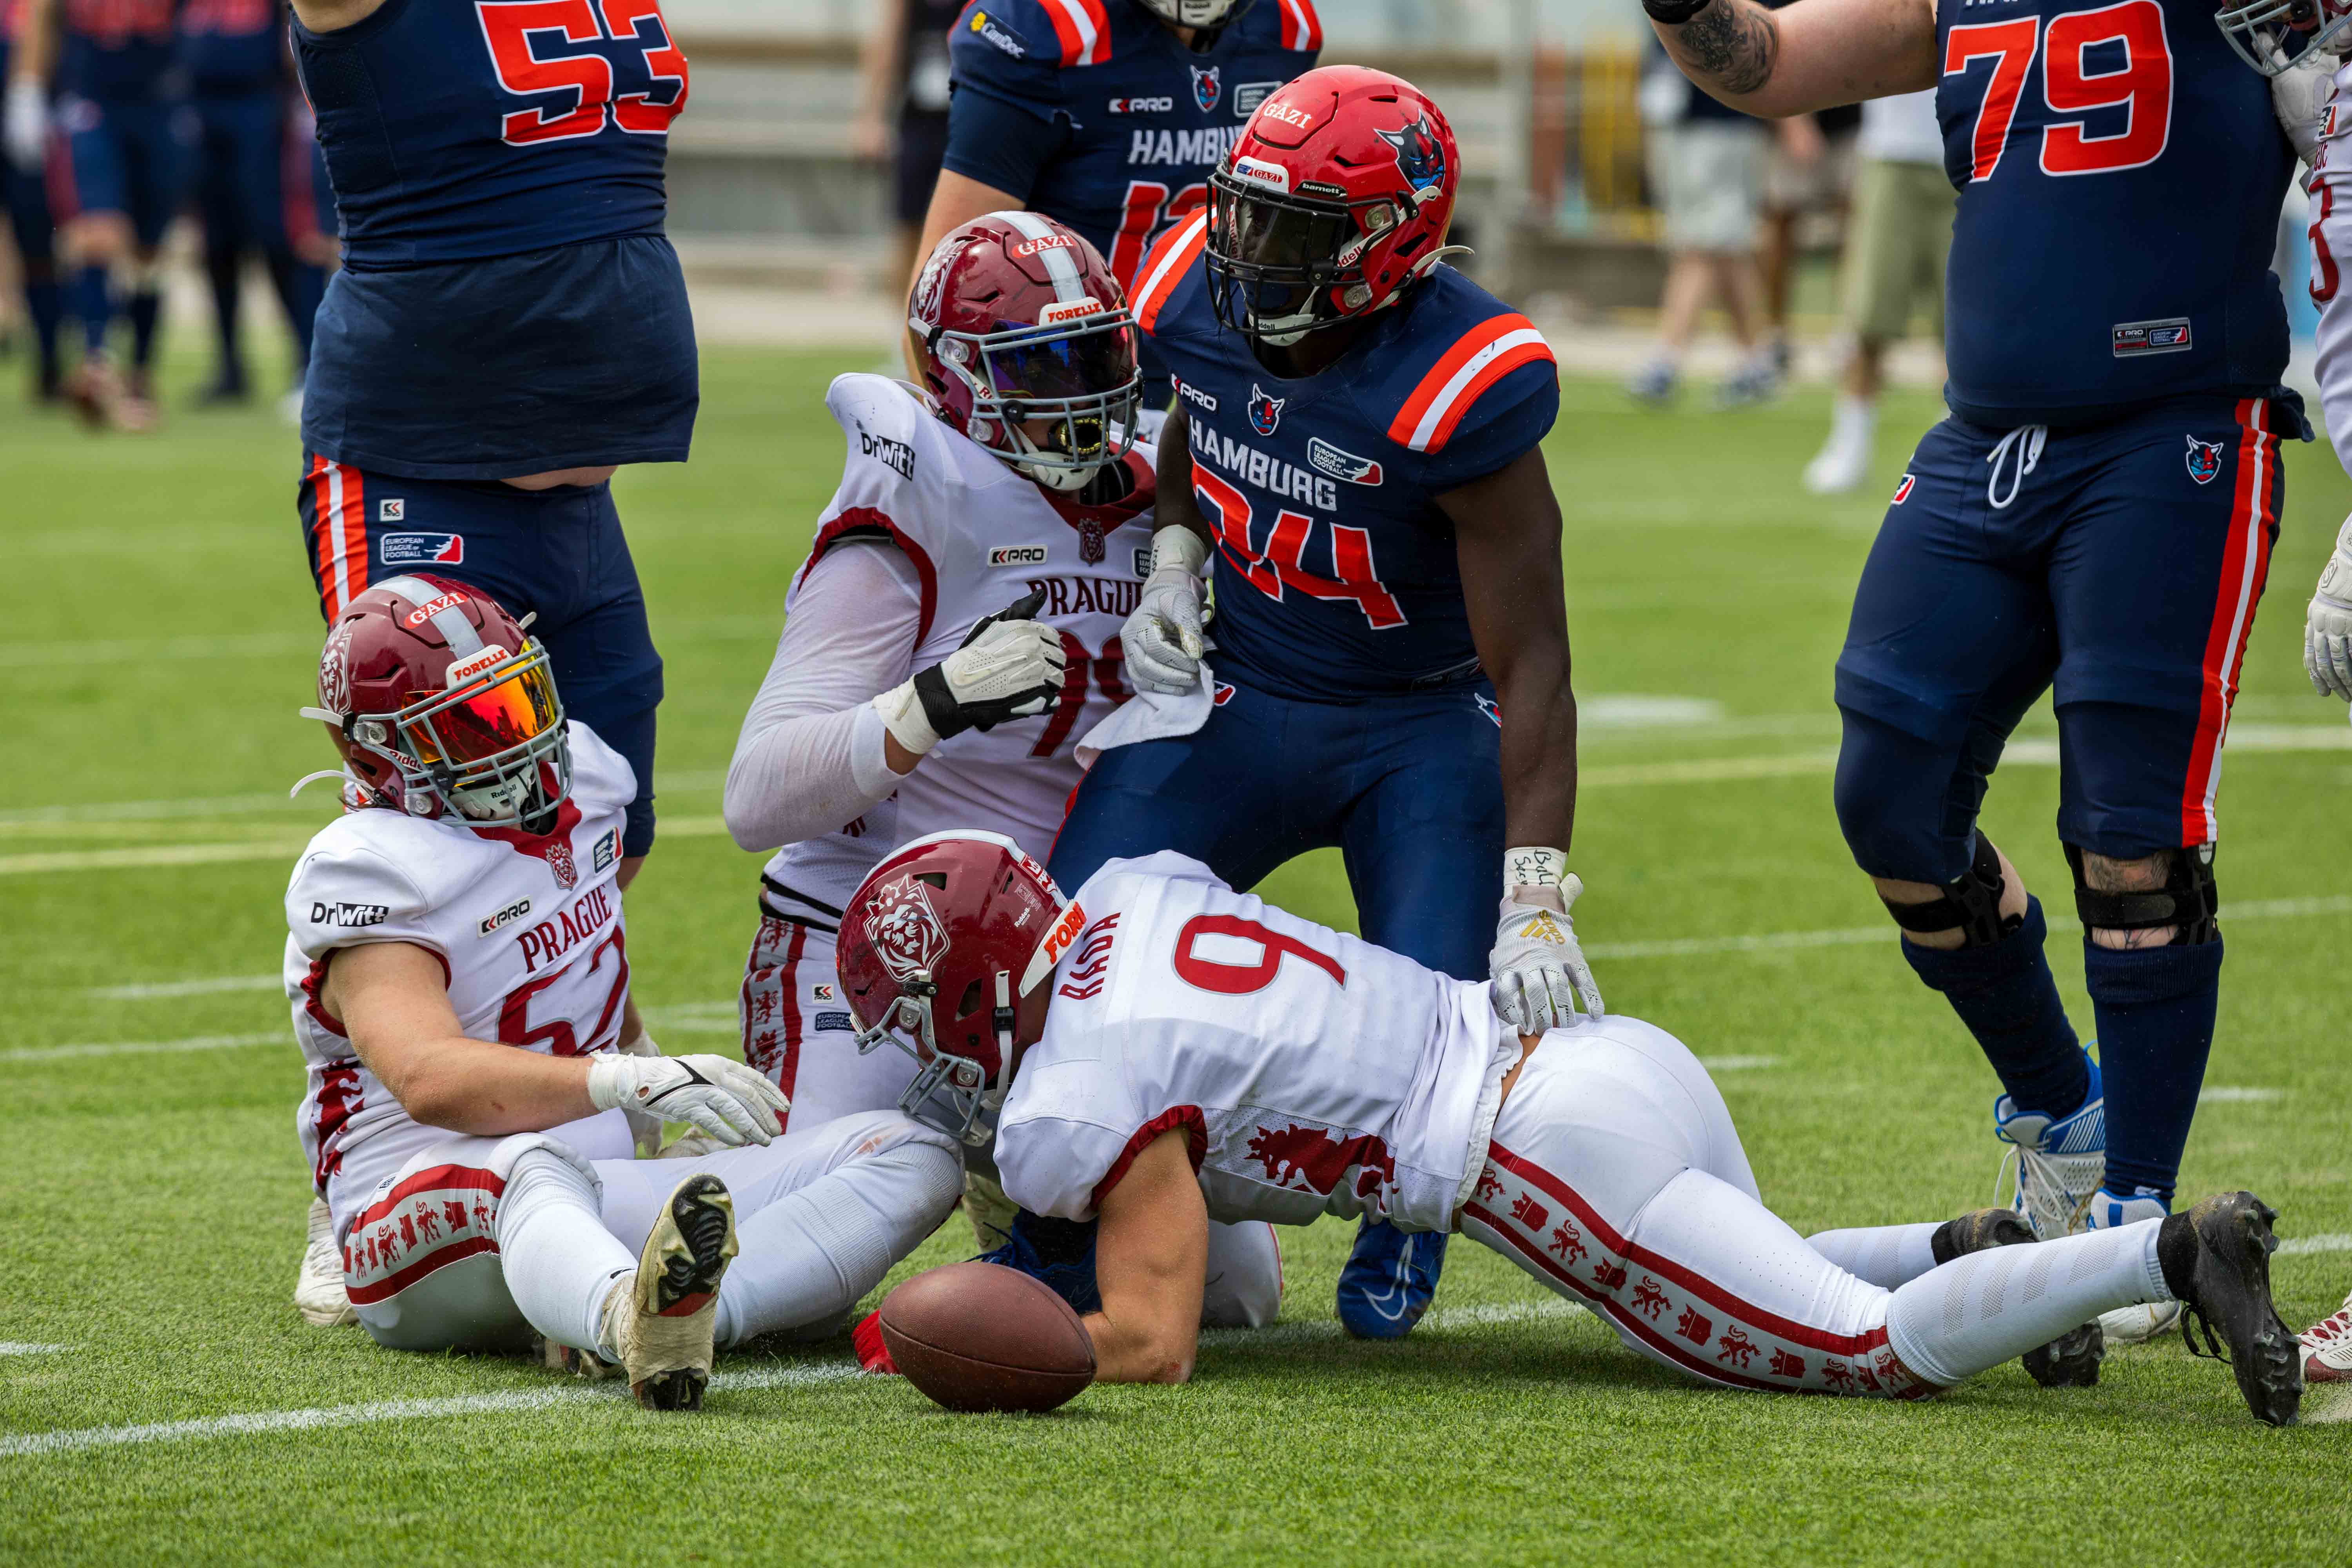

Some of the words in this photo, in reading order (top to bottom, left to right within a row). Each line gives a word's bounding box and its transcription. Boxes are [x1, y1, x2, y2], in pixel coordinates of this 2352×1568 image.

[474, 0, 689, 146] 53
[1944, 0, 2173, 183] 79
[1302, 183, 1339, 194] barnett
[1047, 303, 1102, 322] FORELLE
[1189, 414, 1337, 511] HAMBURG
[1314, 445, 1347, 464] EUROPEAN
[1314, 451, 1336, 466] LEAGUE
[1314, 457, 1345, 475] FOOTBALL
[454, 649, 508, 681] FORELLE
[516, 884, 613, 974] PRAGUE
[1538, 909, 1566, 946] adidas
[1058, 912, 1122, 1000] RADA
[1170, 912, 1348, 997] 9
